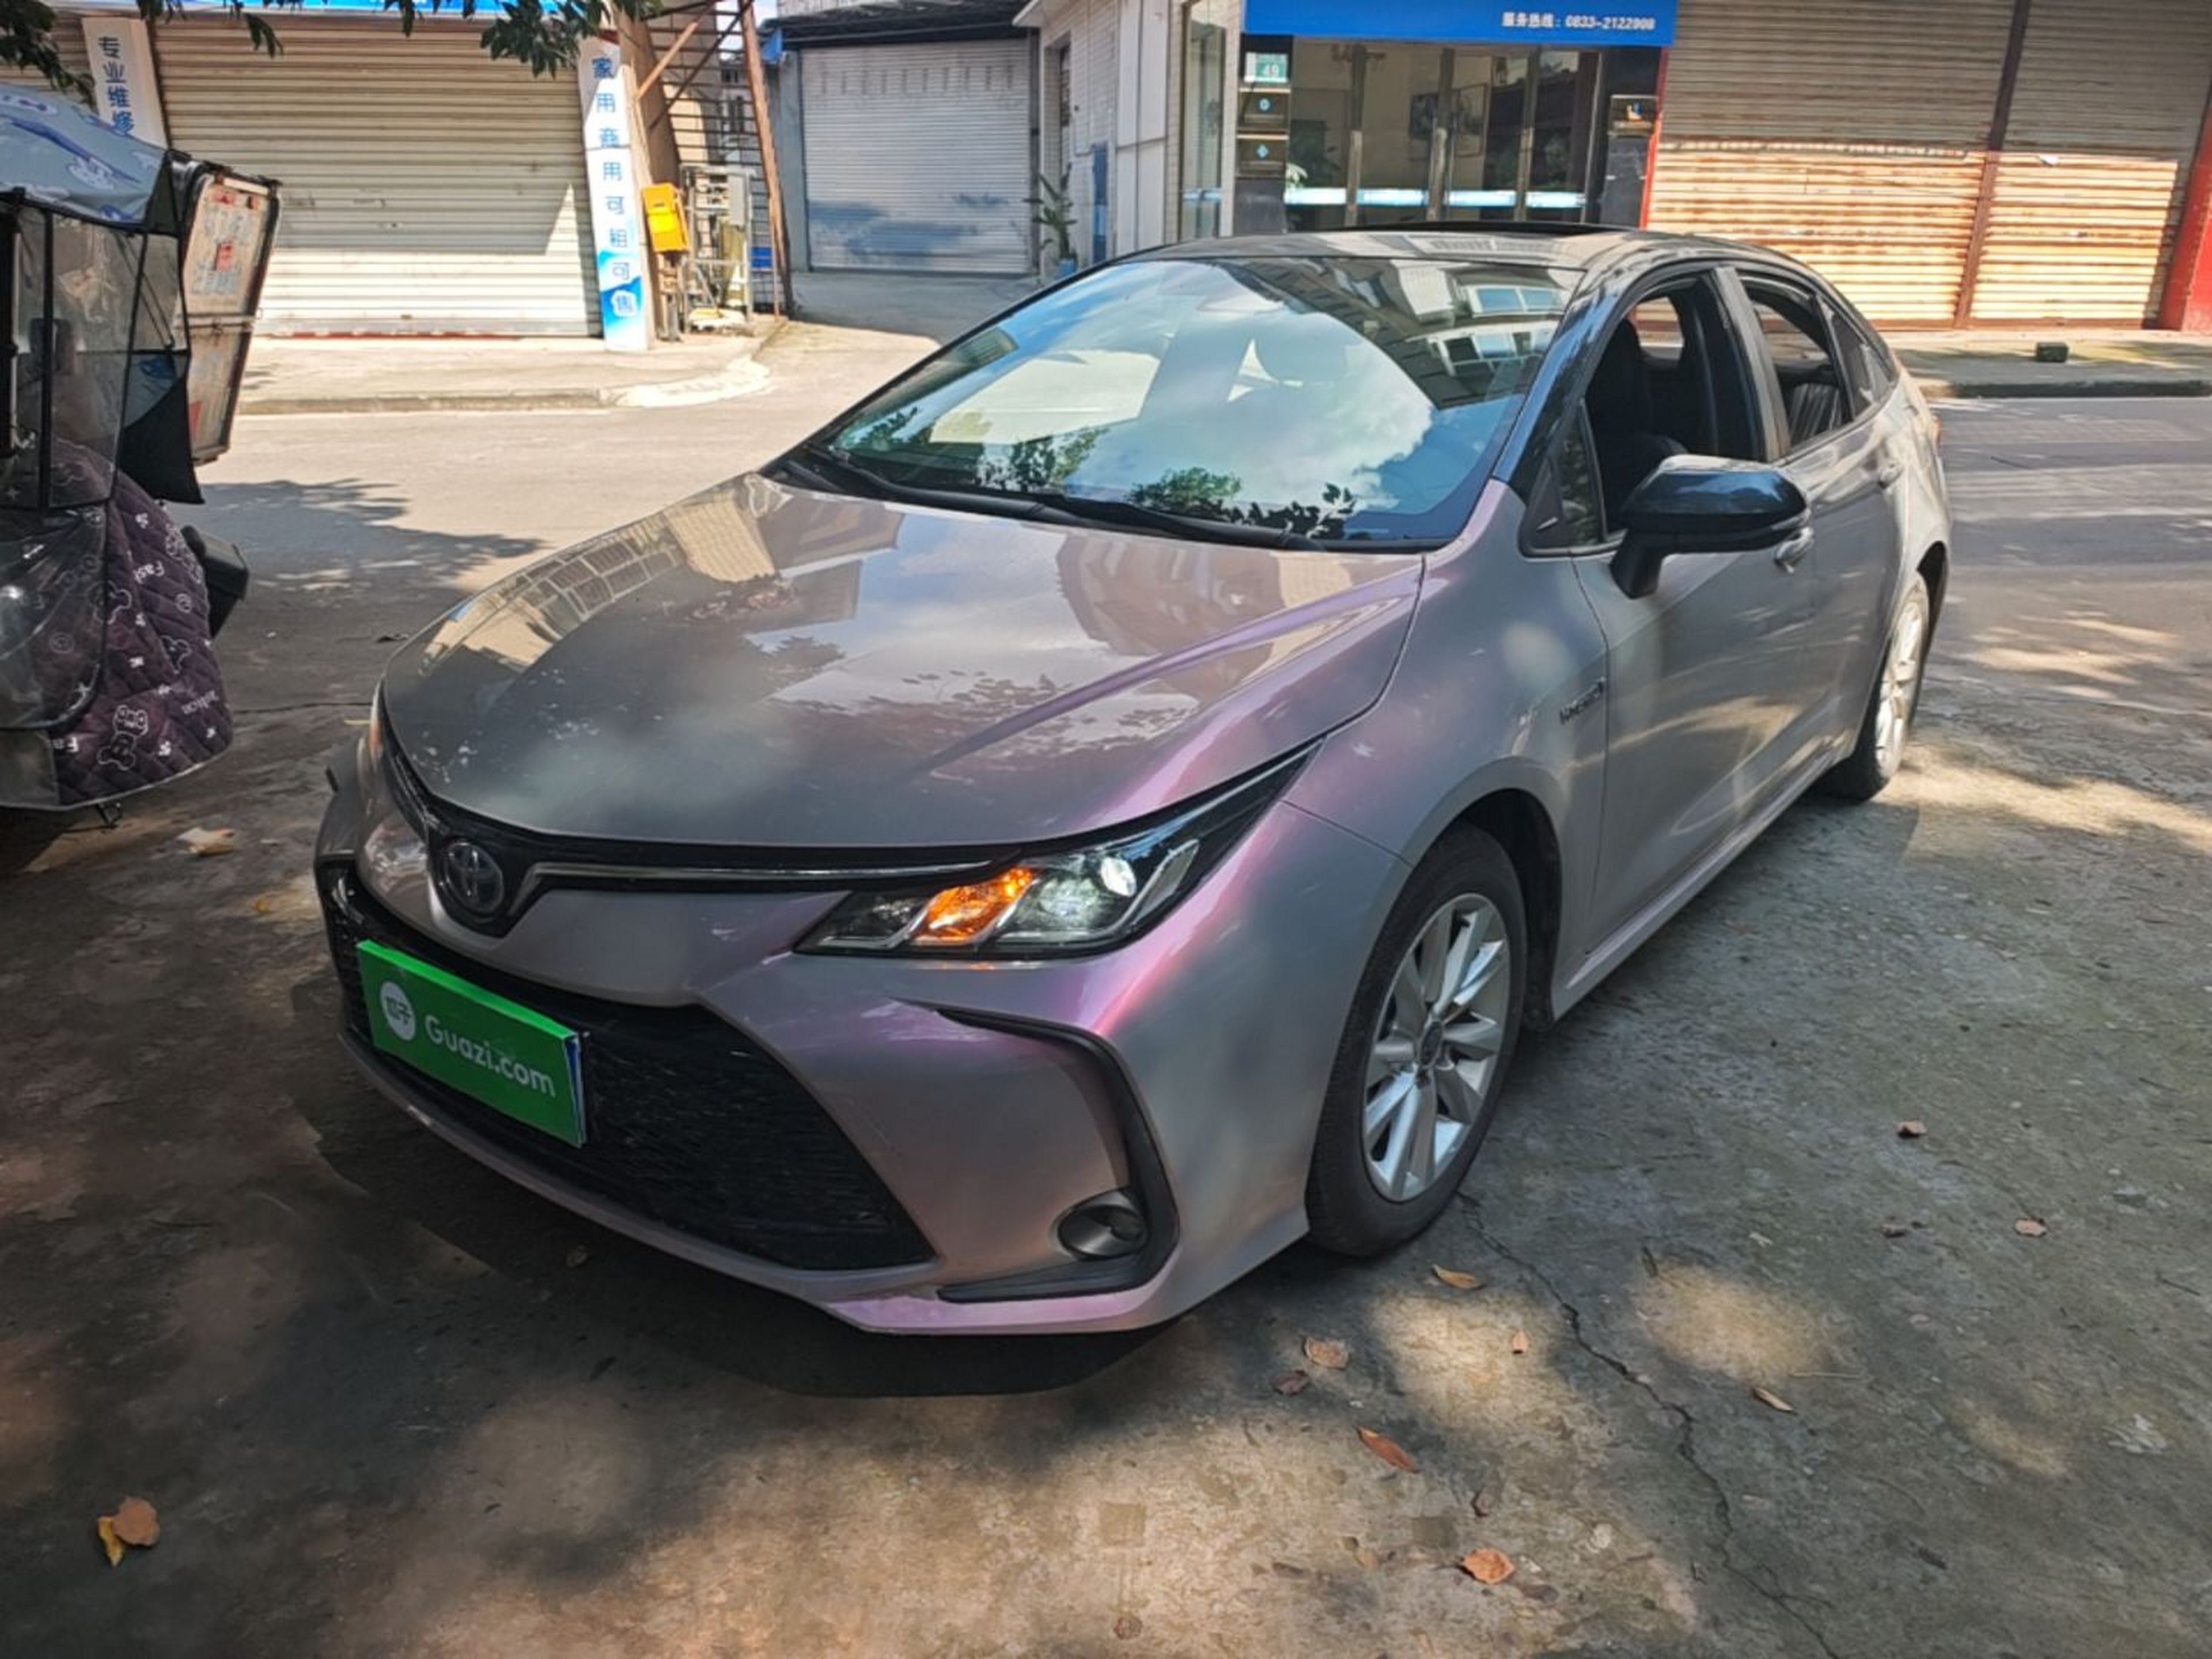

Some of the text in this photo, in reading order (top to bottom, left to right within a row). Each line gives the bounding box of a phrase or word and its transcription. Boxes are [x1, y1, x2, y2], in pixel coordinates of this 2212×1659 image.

[98, 36, 135, 134] 专业维修
[425, 1014, 556, 1098] Guazi.com
